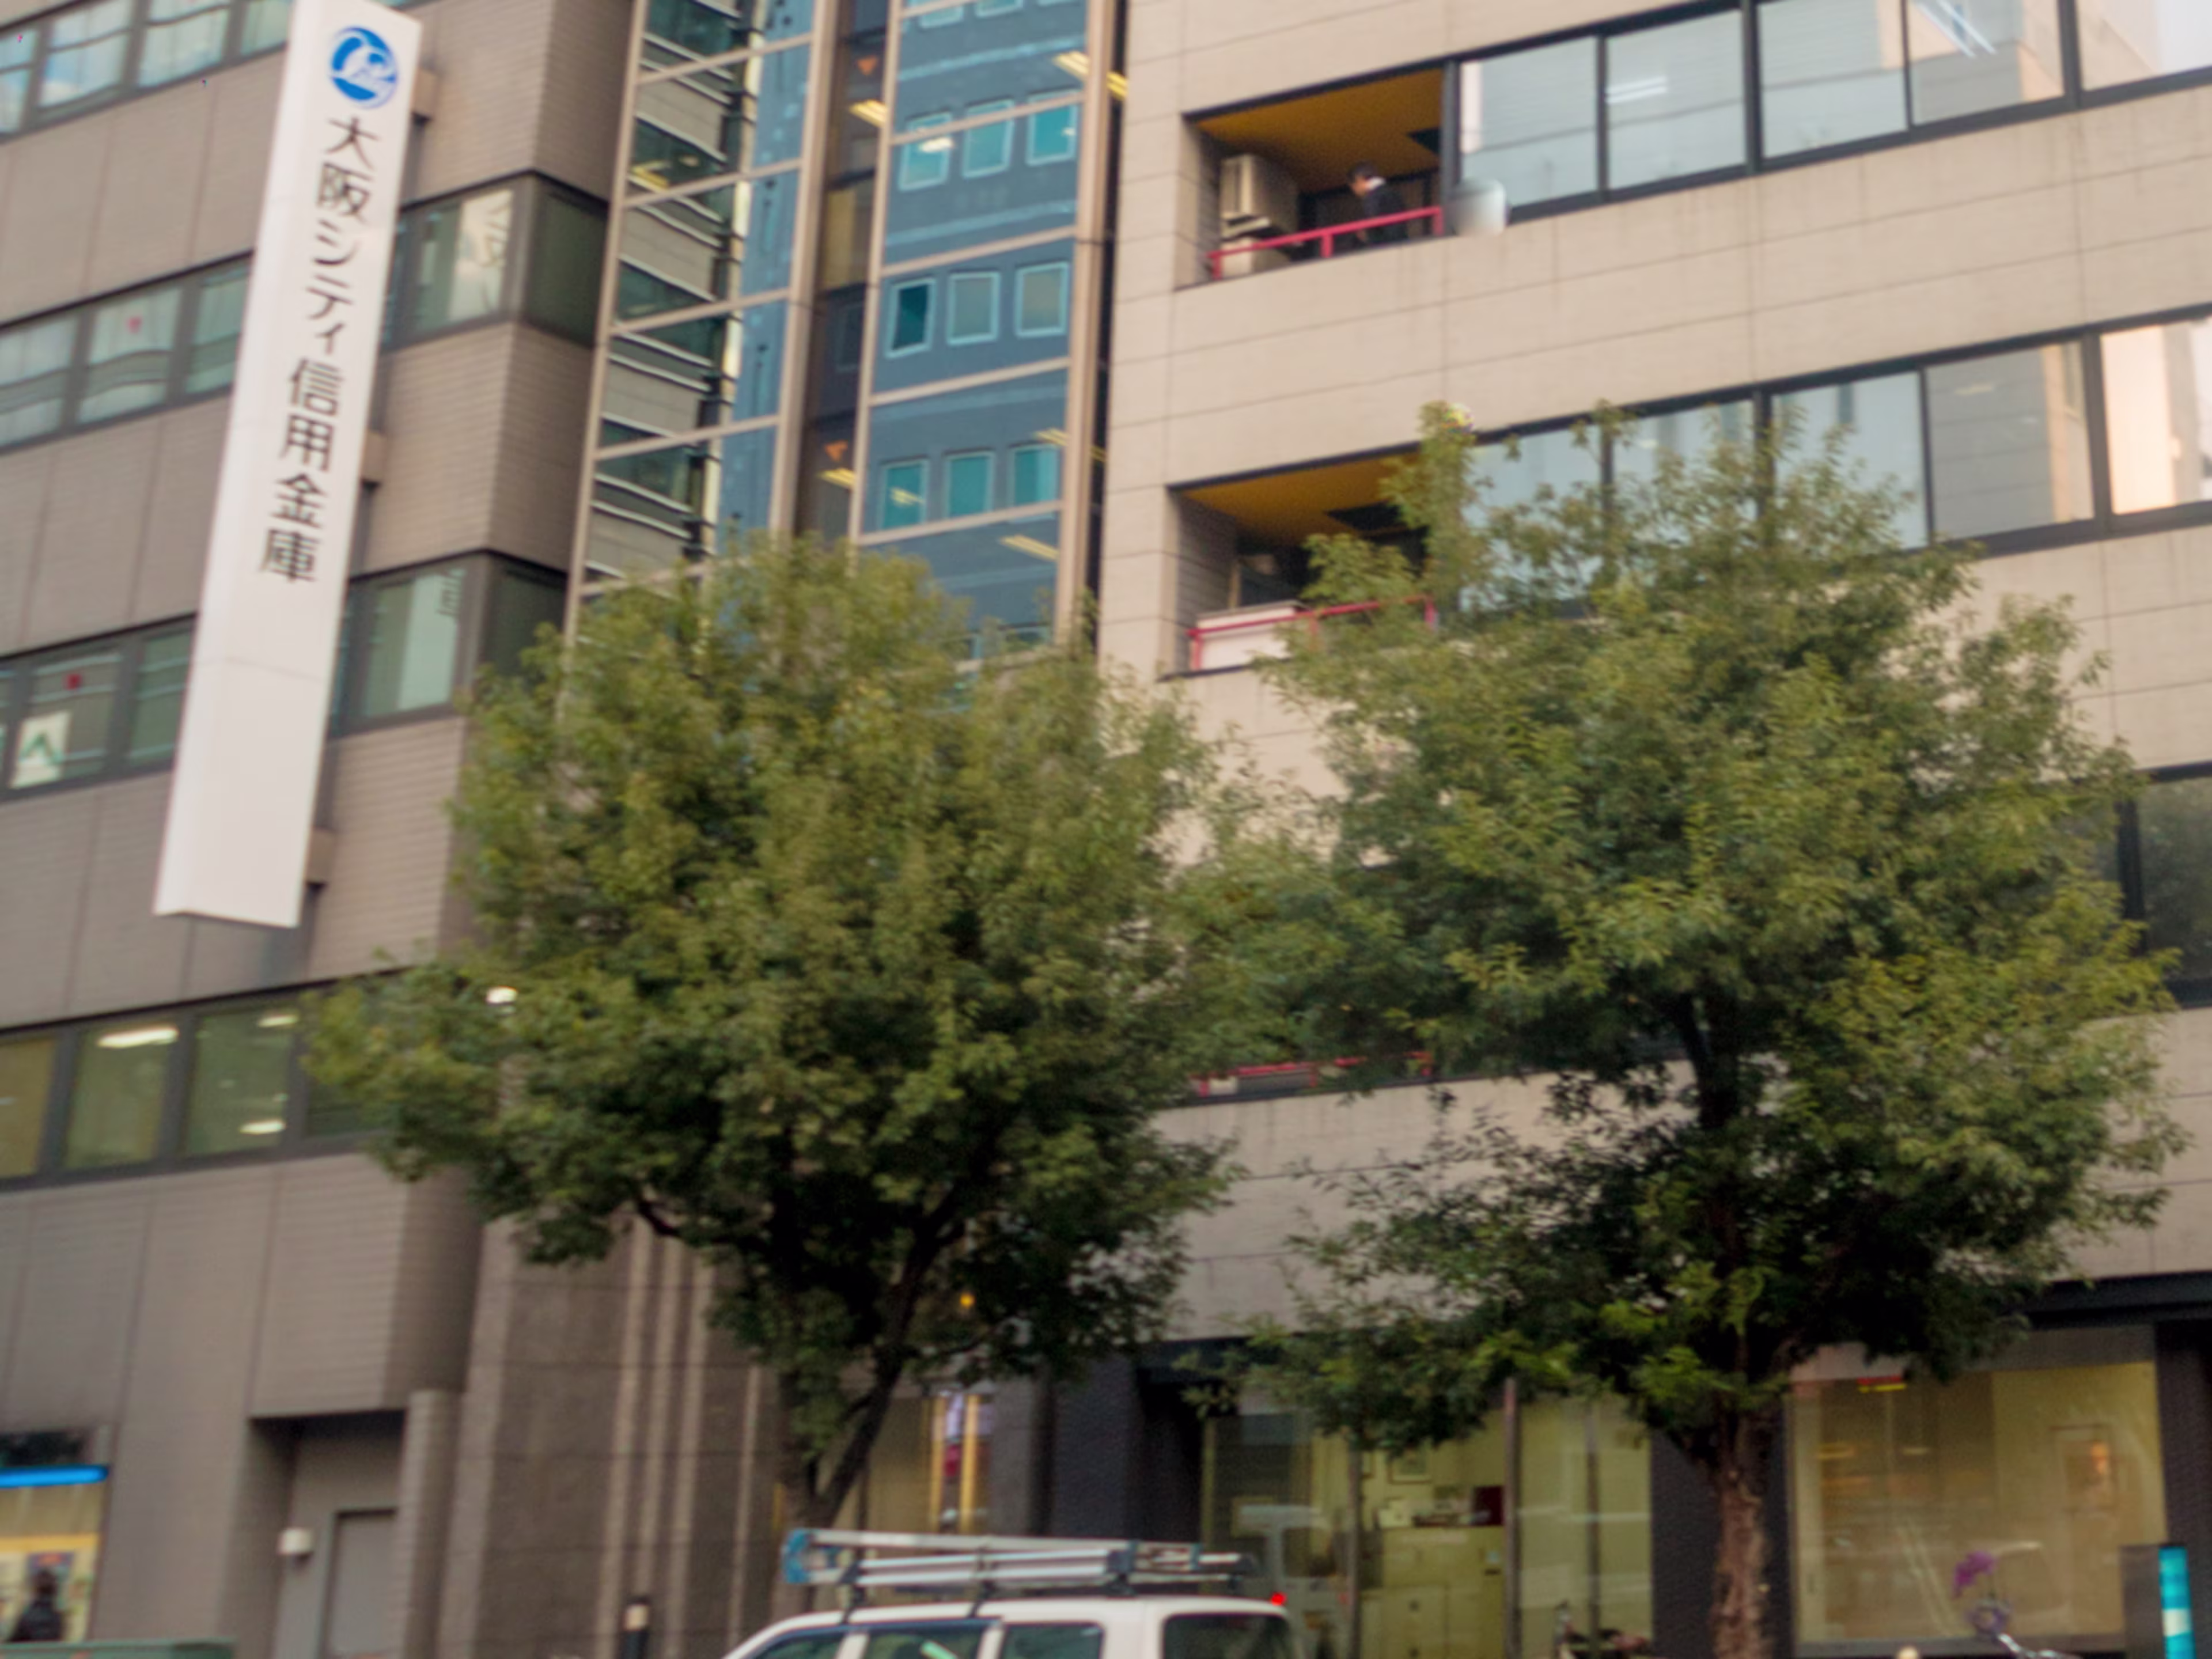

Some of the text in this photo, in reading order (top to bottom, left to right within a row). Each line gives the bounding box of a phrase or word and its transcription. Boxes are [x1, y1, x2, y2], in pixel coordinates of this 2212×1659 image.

[260, 117, 380, 583] 大阪シティ信用金庫
